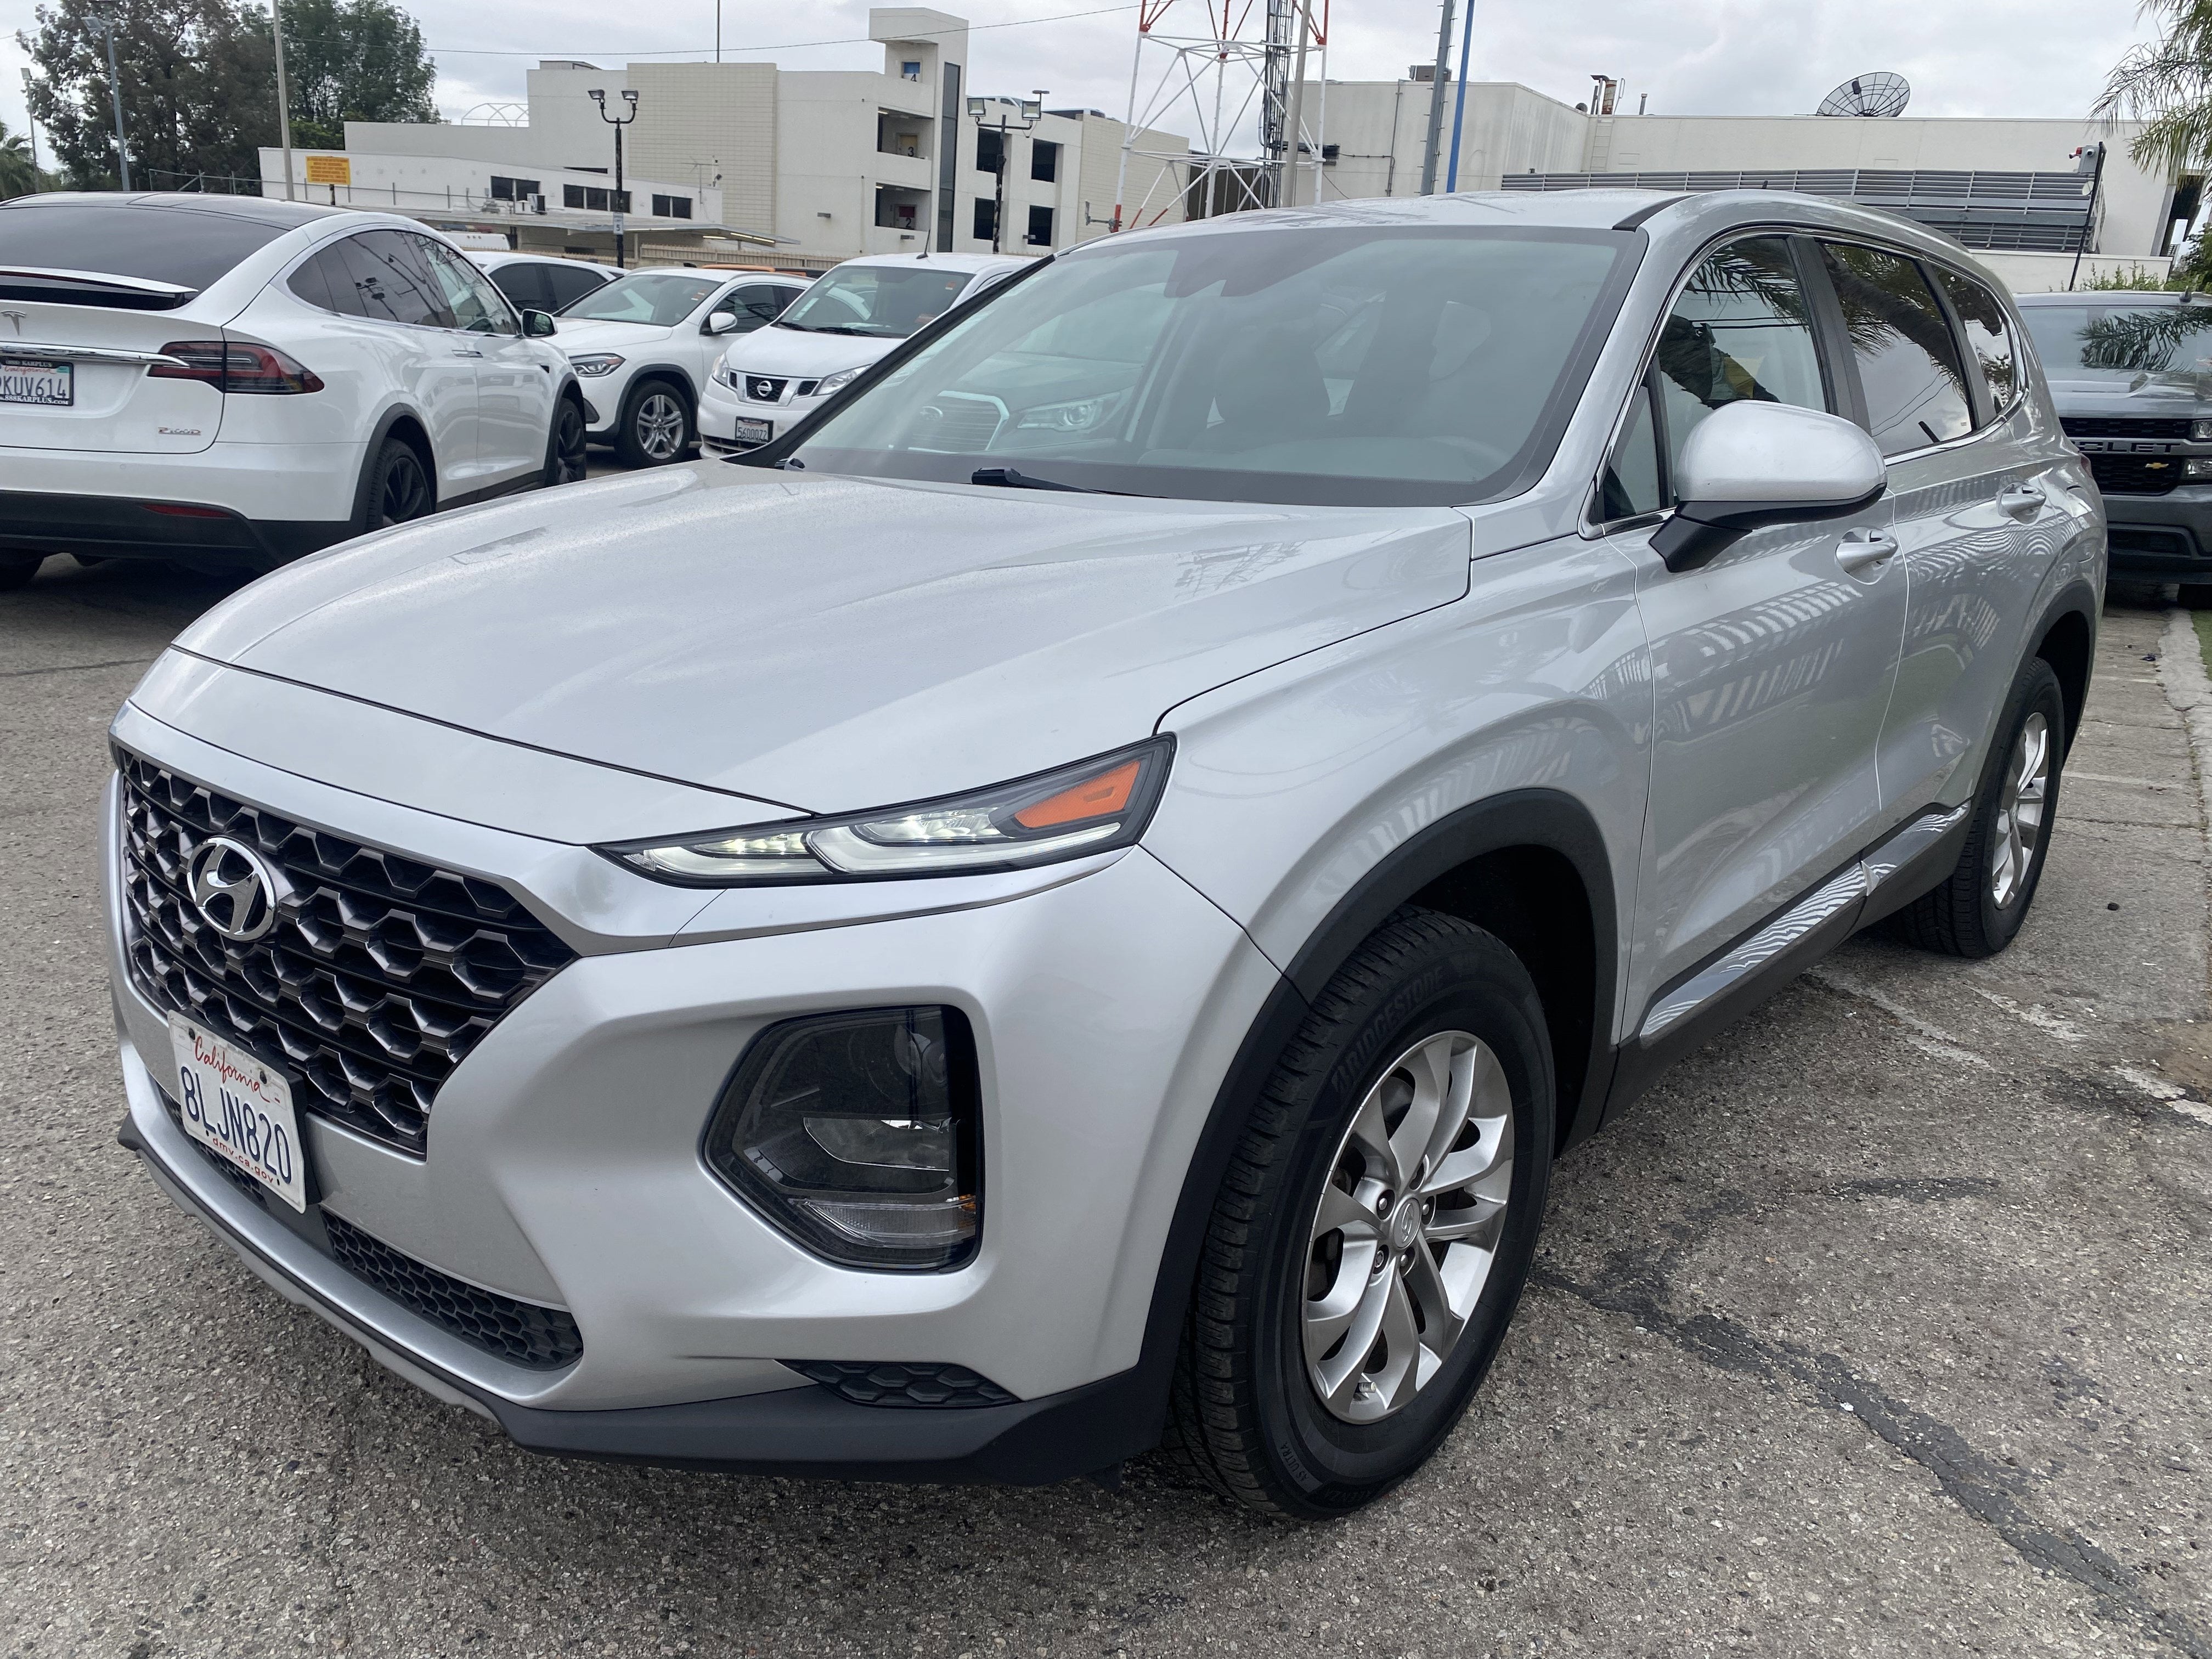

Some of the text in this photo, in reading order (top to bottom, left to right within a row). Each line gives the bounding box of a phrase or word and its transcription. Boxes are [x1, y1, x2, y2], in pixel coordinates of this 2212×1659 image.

[910, 74, 917, 82] 4
[908, 146, 914, 157] 3
[906, 217, 911, 228] 2
[4, 366, 57, 375] California
[2070, 441, 2181, 454] OLET
[1331, 967, 1444, 1094] BRIDGESTONE
[195, 1035, 271, 1103] California
[180, 1065, 292, 1185] 8LJN820
[212, 1137, 274, 1184] dmv.ca.gov
[1280, 1441, 1300, 1473] ULTRA
